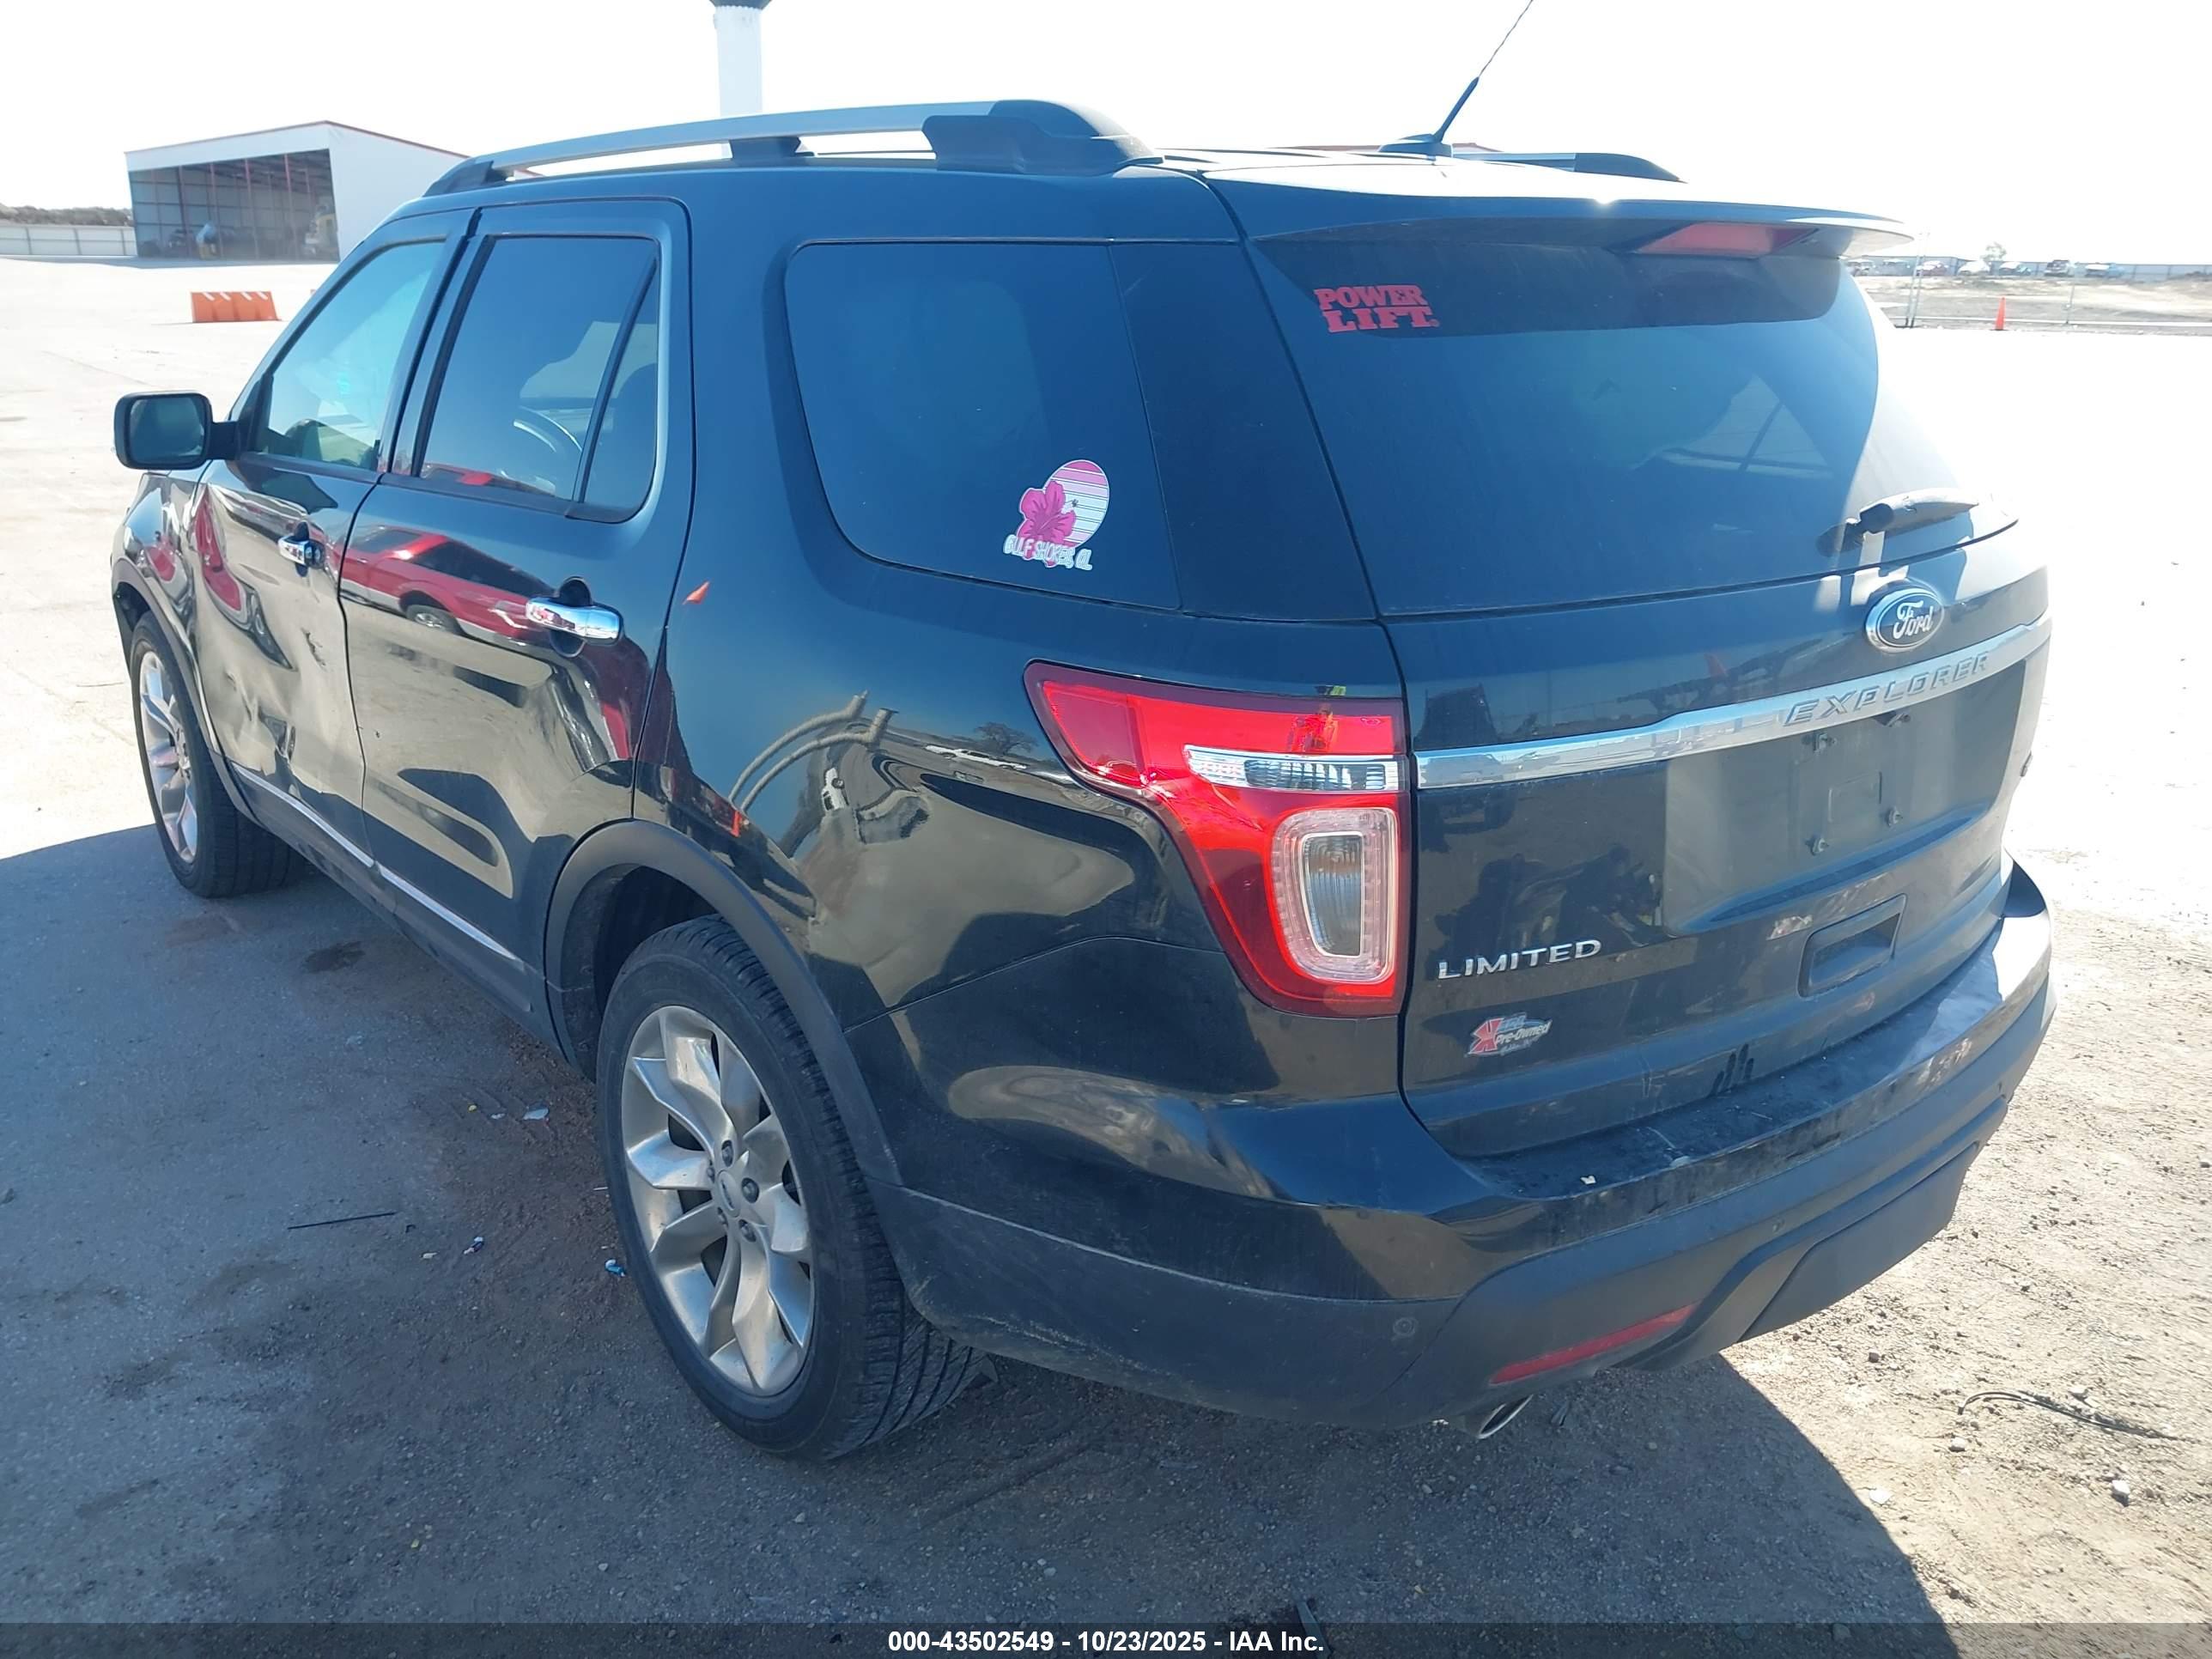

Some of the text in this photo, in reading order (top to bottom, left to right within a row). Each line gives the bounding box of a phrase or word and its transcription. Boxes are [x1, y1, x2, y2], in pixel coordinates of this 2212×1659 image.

[1314, 284, 1429, 310] POWER
[1893, 600, 1934, 639] Ford
[1784, 651, 1990, 726] EXPLORER
[1437, 939, 1602, 980] LIMITED
